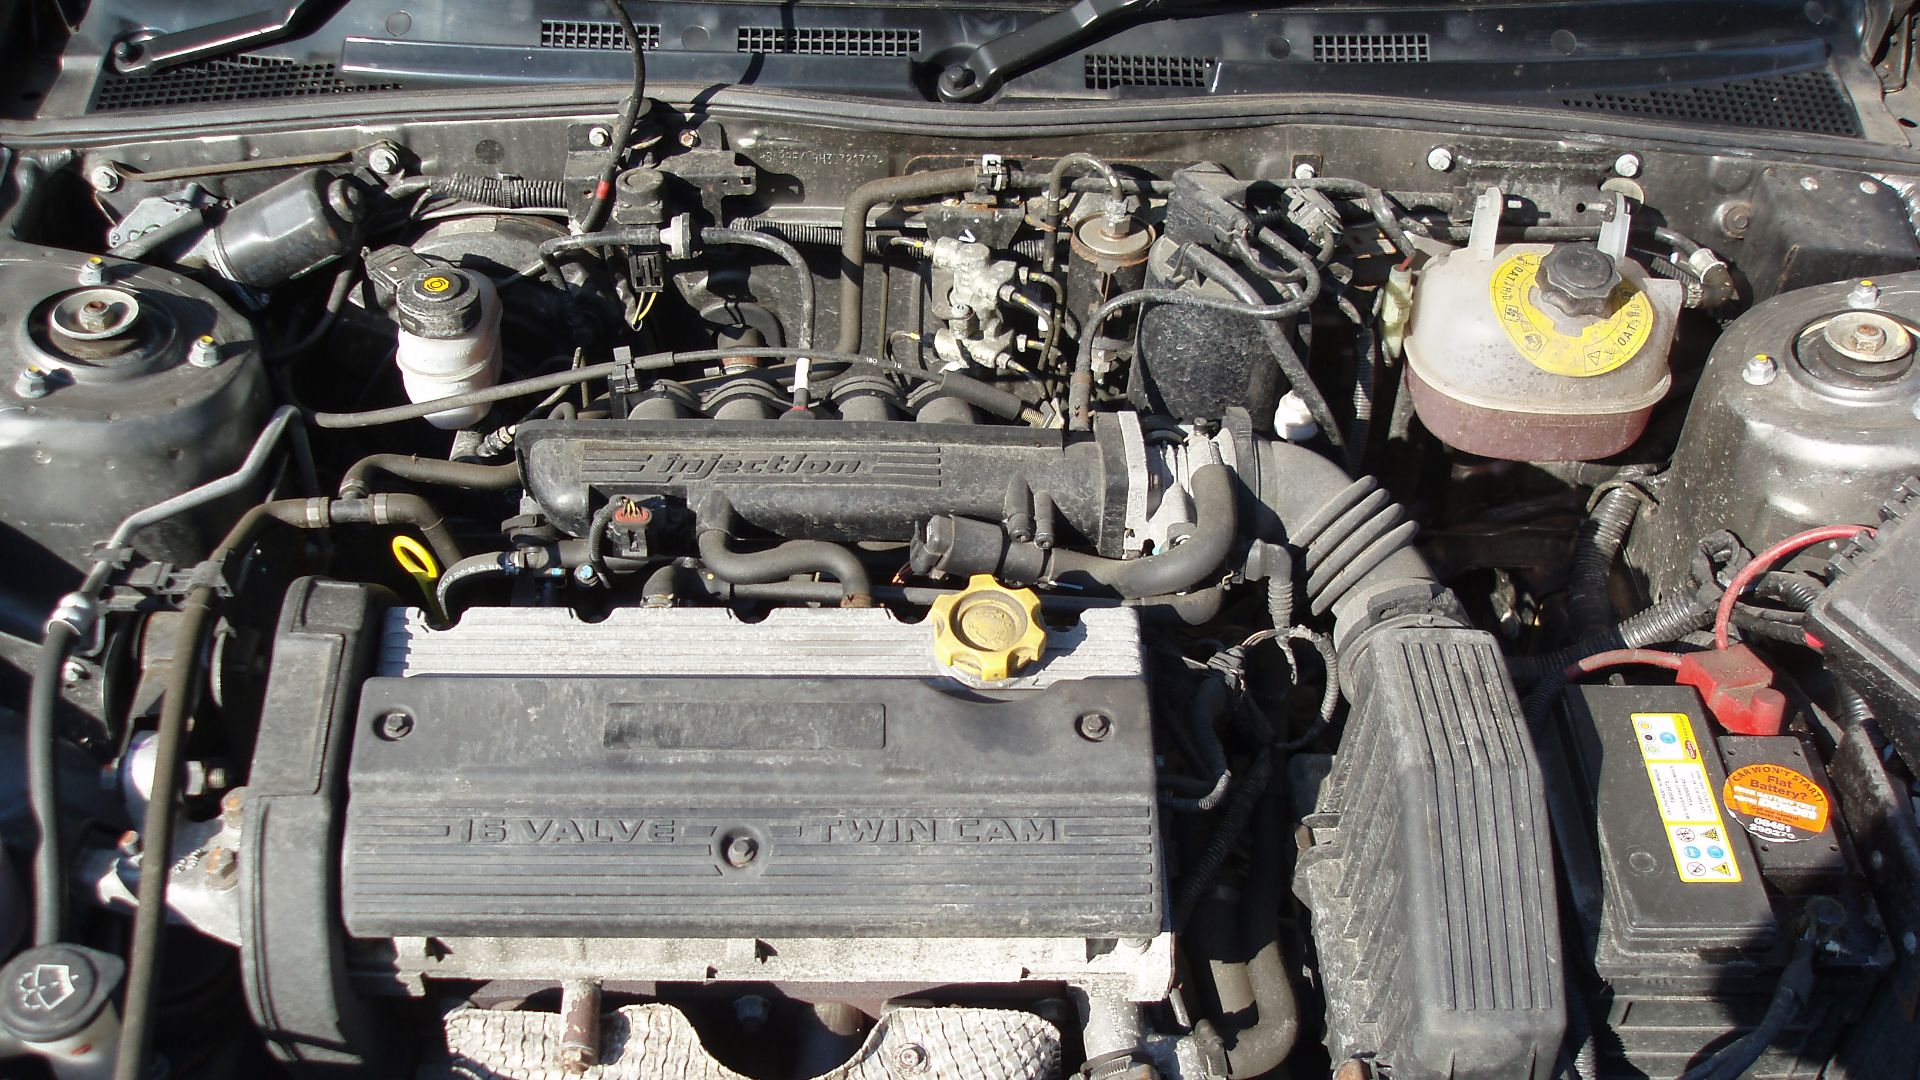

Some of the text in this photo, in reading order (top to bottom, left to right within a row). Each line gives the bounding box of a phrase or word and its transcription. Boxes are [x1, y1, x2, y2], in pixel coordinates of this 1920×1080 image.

[657, 453, 862, 481] injection
[1732, 766, 1824, 802] CAR WON'T START?
[1750, 779, 1808, 800] Battery?
[1767, 775, 1793, 788] Flat
[459, 818, 1057, 843] 16 VALVE TWIN CAM
